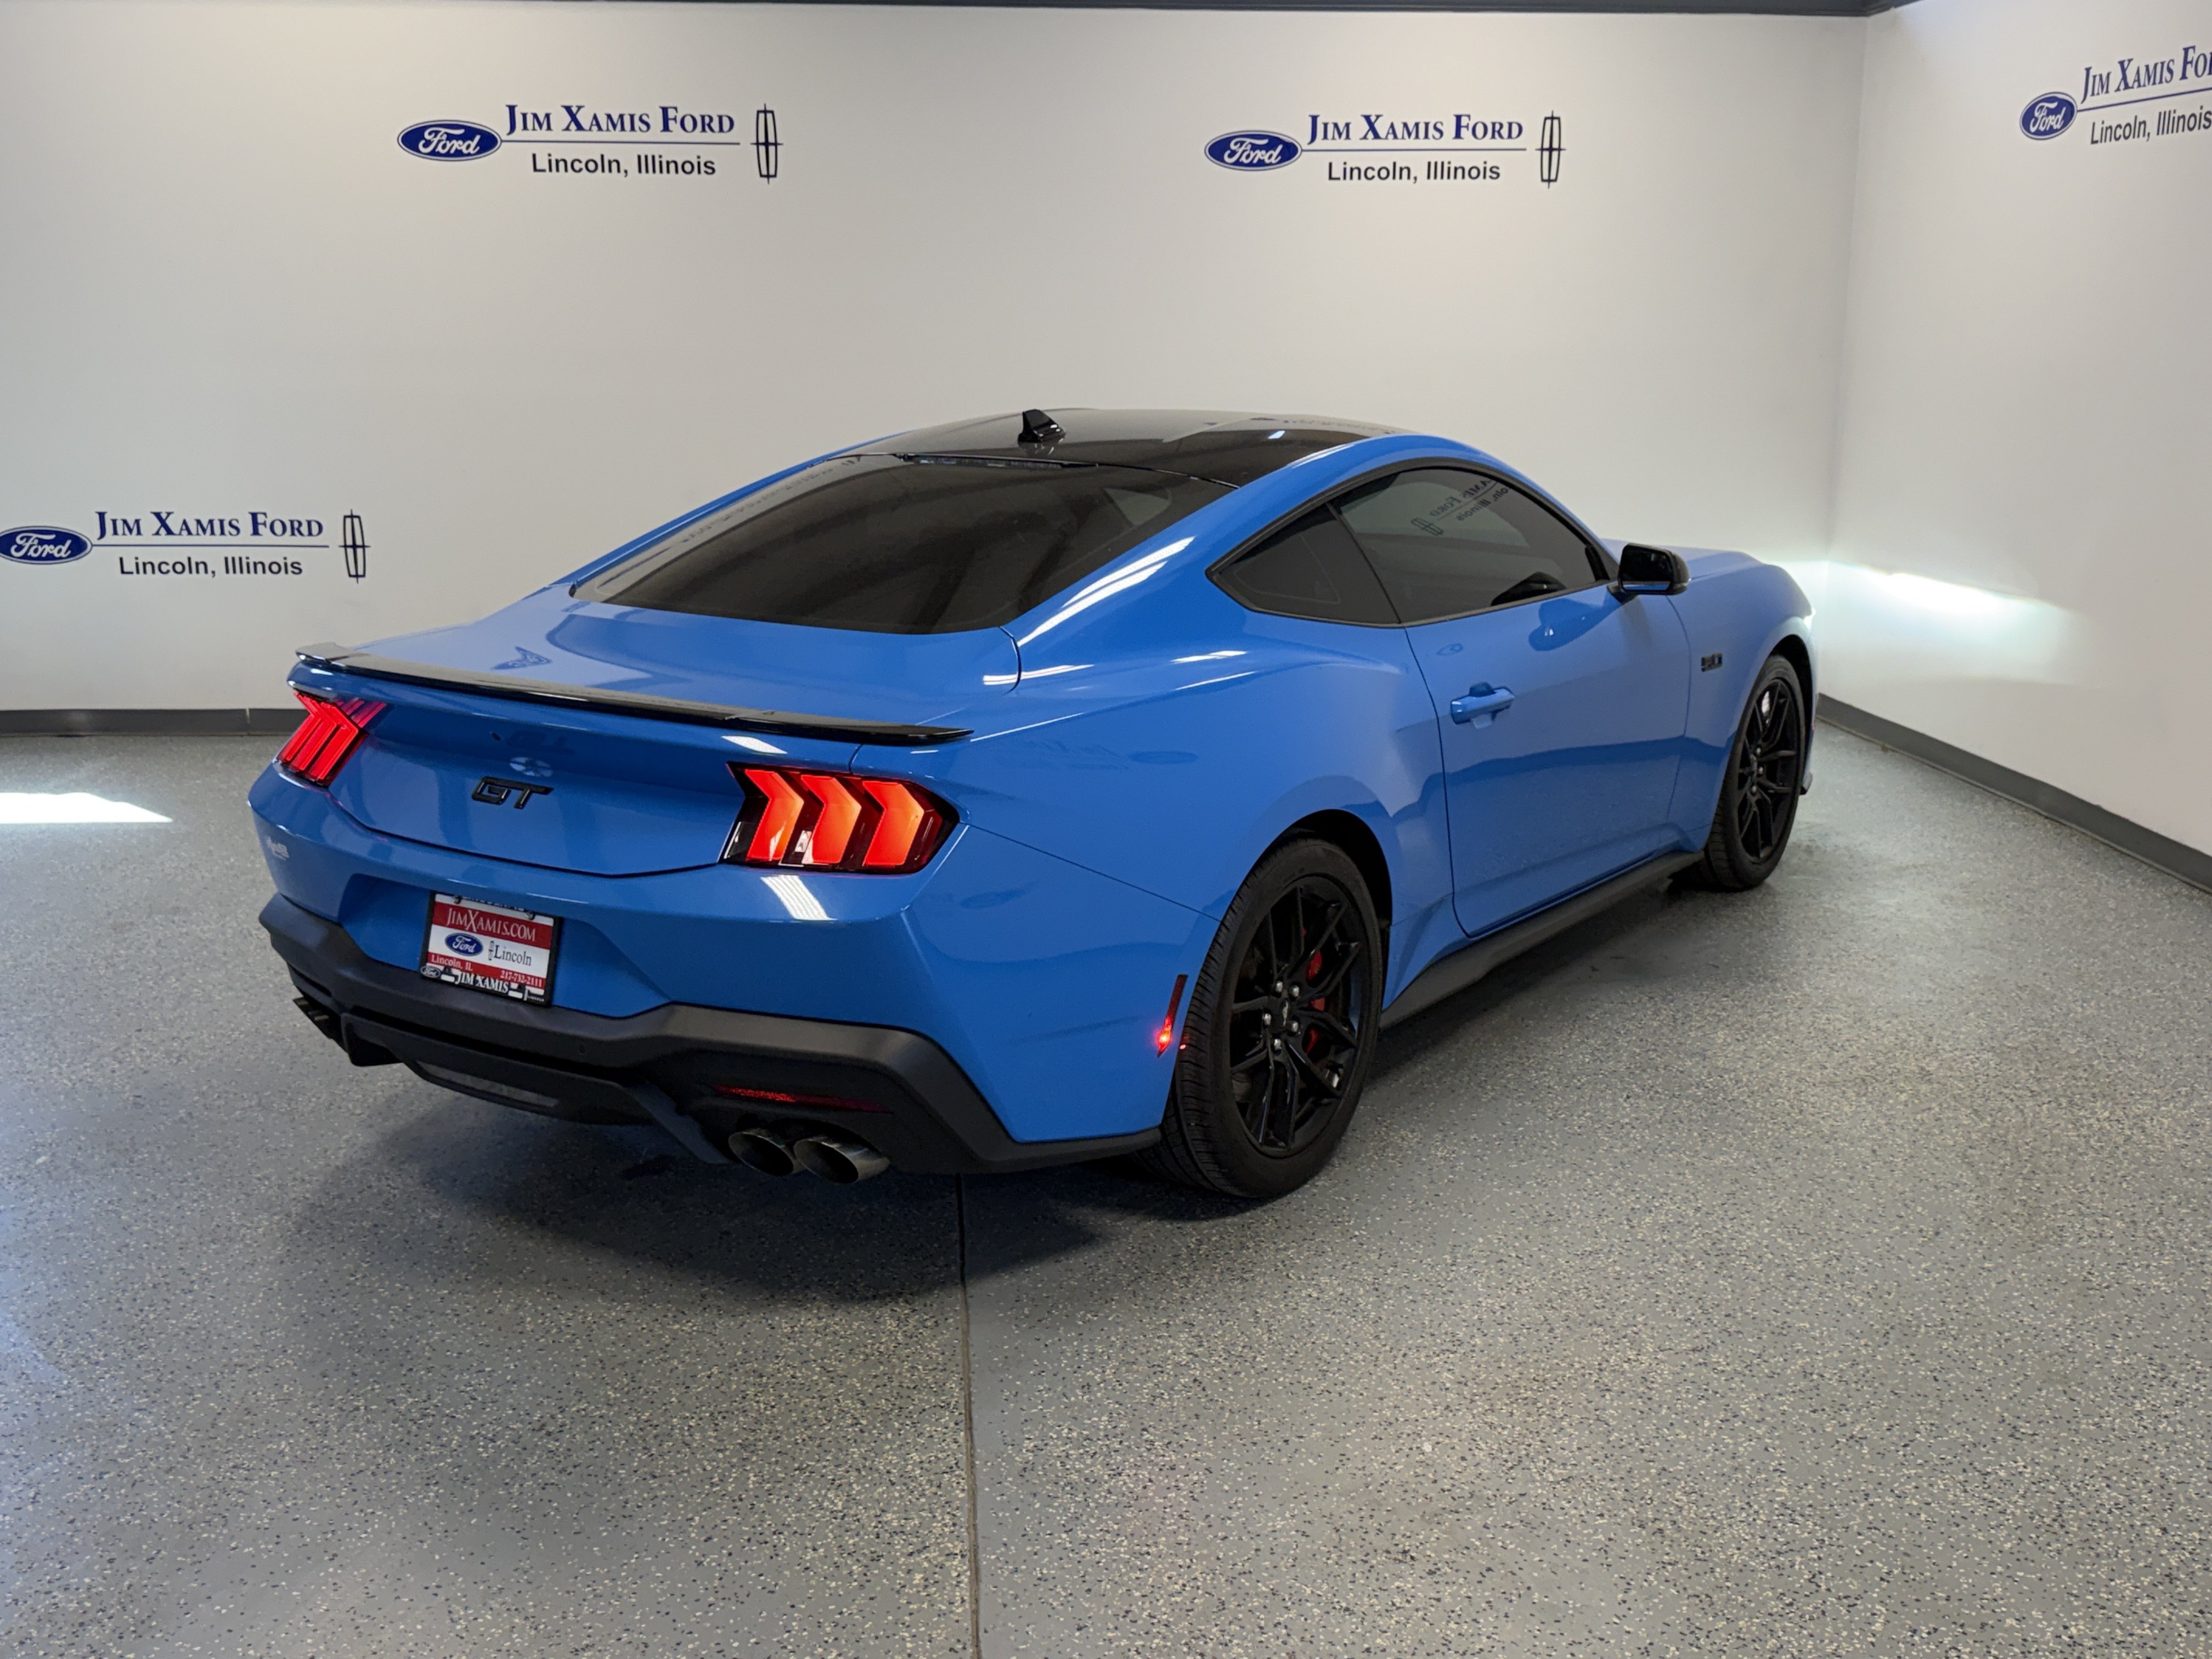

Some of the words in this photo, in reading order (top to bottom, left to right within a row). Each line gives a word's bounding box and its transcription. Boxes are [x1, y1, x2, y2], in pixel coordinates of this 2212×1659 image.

[2081, 66, 2112, 104] JIM
[2114, 58, 2174, 92] XAMIS
[2179, 45, 2212, 81] FO
[505, 105, 553, 136] JIM
[561, 105, 651, 133] XAMIS
[659, 106, 735, 134] FORD
[1307, 115, 1351, 145] JIM
[1359, 114, 1444, 140] XAMIS
[1453, 114, 1523, 140] FORD
[2030, 101, 2067, 133] Ford
[2090, 115, 2150, 145] Lincoln,
[418, 126, 481, 155] Ford
[1223, 137, 1284, 166] Ford
[532, 153, 629, 178] Lincoln,
[637, 154, 716, 176] Illinois
[1328, 161, 1418, 184] Lincoln,
[1427, 161, 1501, 180] Illinois
[95, 511, 143, 540] JIM
[150, 511, 241, 537] XAMIS
[249, 512, 324, 537] FORD
[10, 532, 72, 560] Ford
[119, 556, 216, 578] Lincoln,
[224, 556, 303, 575] Illinois
[472, 776, 554, 810] GT
[447, 907, 536, 942] JIMXAMIS.COM
[452, 935, 476, 953] Ford
[494, 944, 532, 966] Lincoln
[431, 954, 464, 969] Lincoln,
[454, 972, 475, 985] JIM
[475, 974, 509, 994] XAMIS
